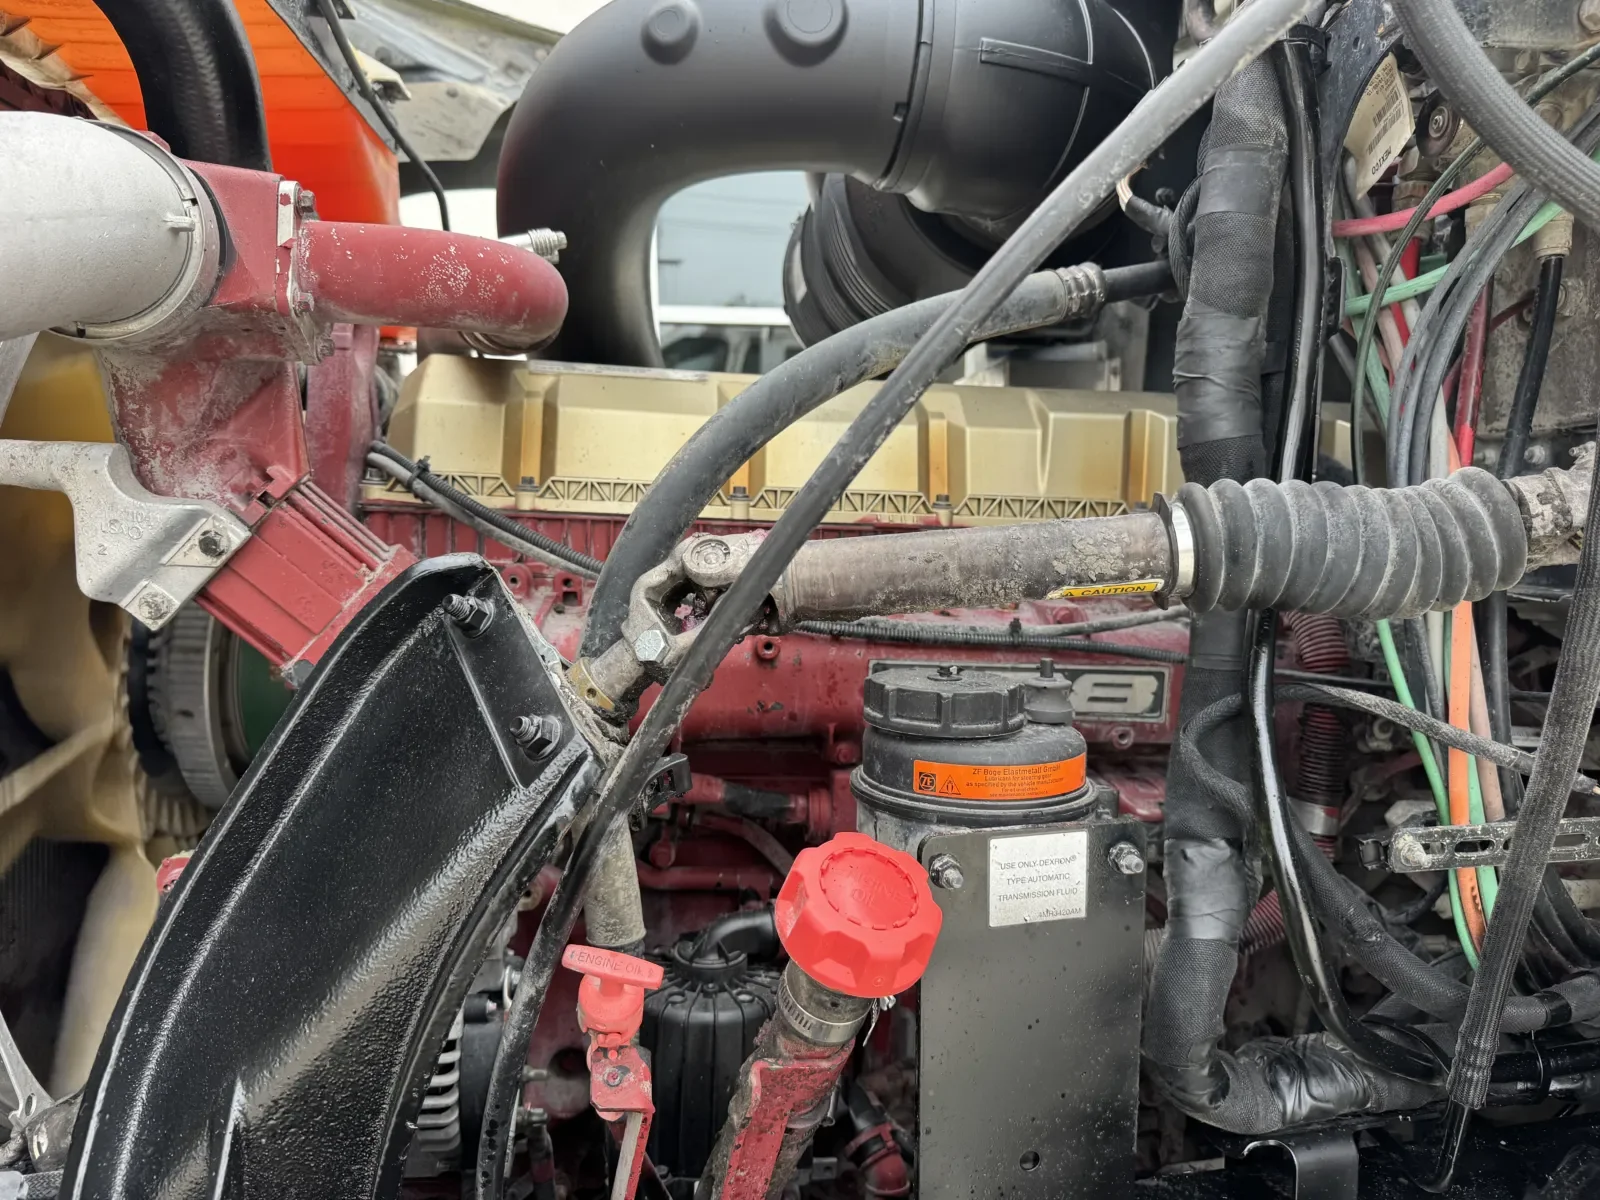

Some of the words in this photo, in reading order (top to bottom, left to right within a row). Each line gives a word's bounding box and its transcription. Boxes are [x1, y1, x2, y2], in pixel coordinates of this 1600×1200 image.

[1370, 145, 1392, 175] MEXICO
[97, 544, 108, 555] 2
[1081, 585, 1147, 596] CAUTION
[983, 768, 1001, 776] Boge
[1003, 767, 1042, 776] Elastmetall
[1043, 765, 1061, 773] GmbH
[920, 774, 935, 788] ZF
[1000, 862, 1016, 870] USE
[1018, 860, 1037, 869] ONLY
[1007, 877, 1026, 885] TYPE
[1028, 873, 1070, 883] AUTOMATIC
[999, 890, 1055, 902] TRANSMISSION
[1057, 887, 1078, 896] FLUID
[577, 951, 624, 972] ENGINE
[625, 962, 644, 977] OIL
